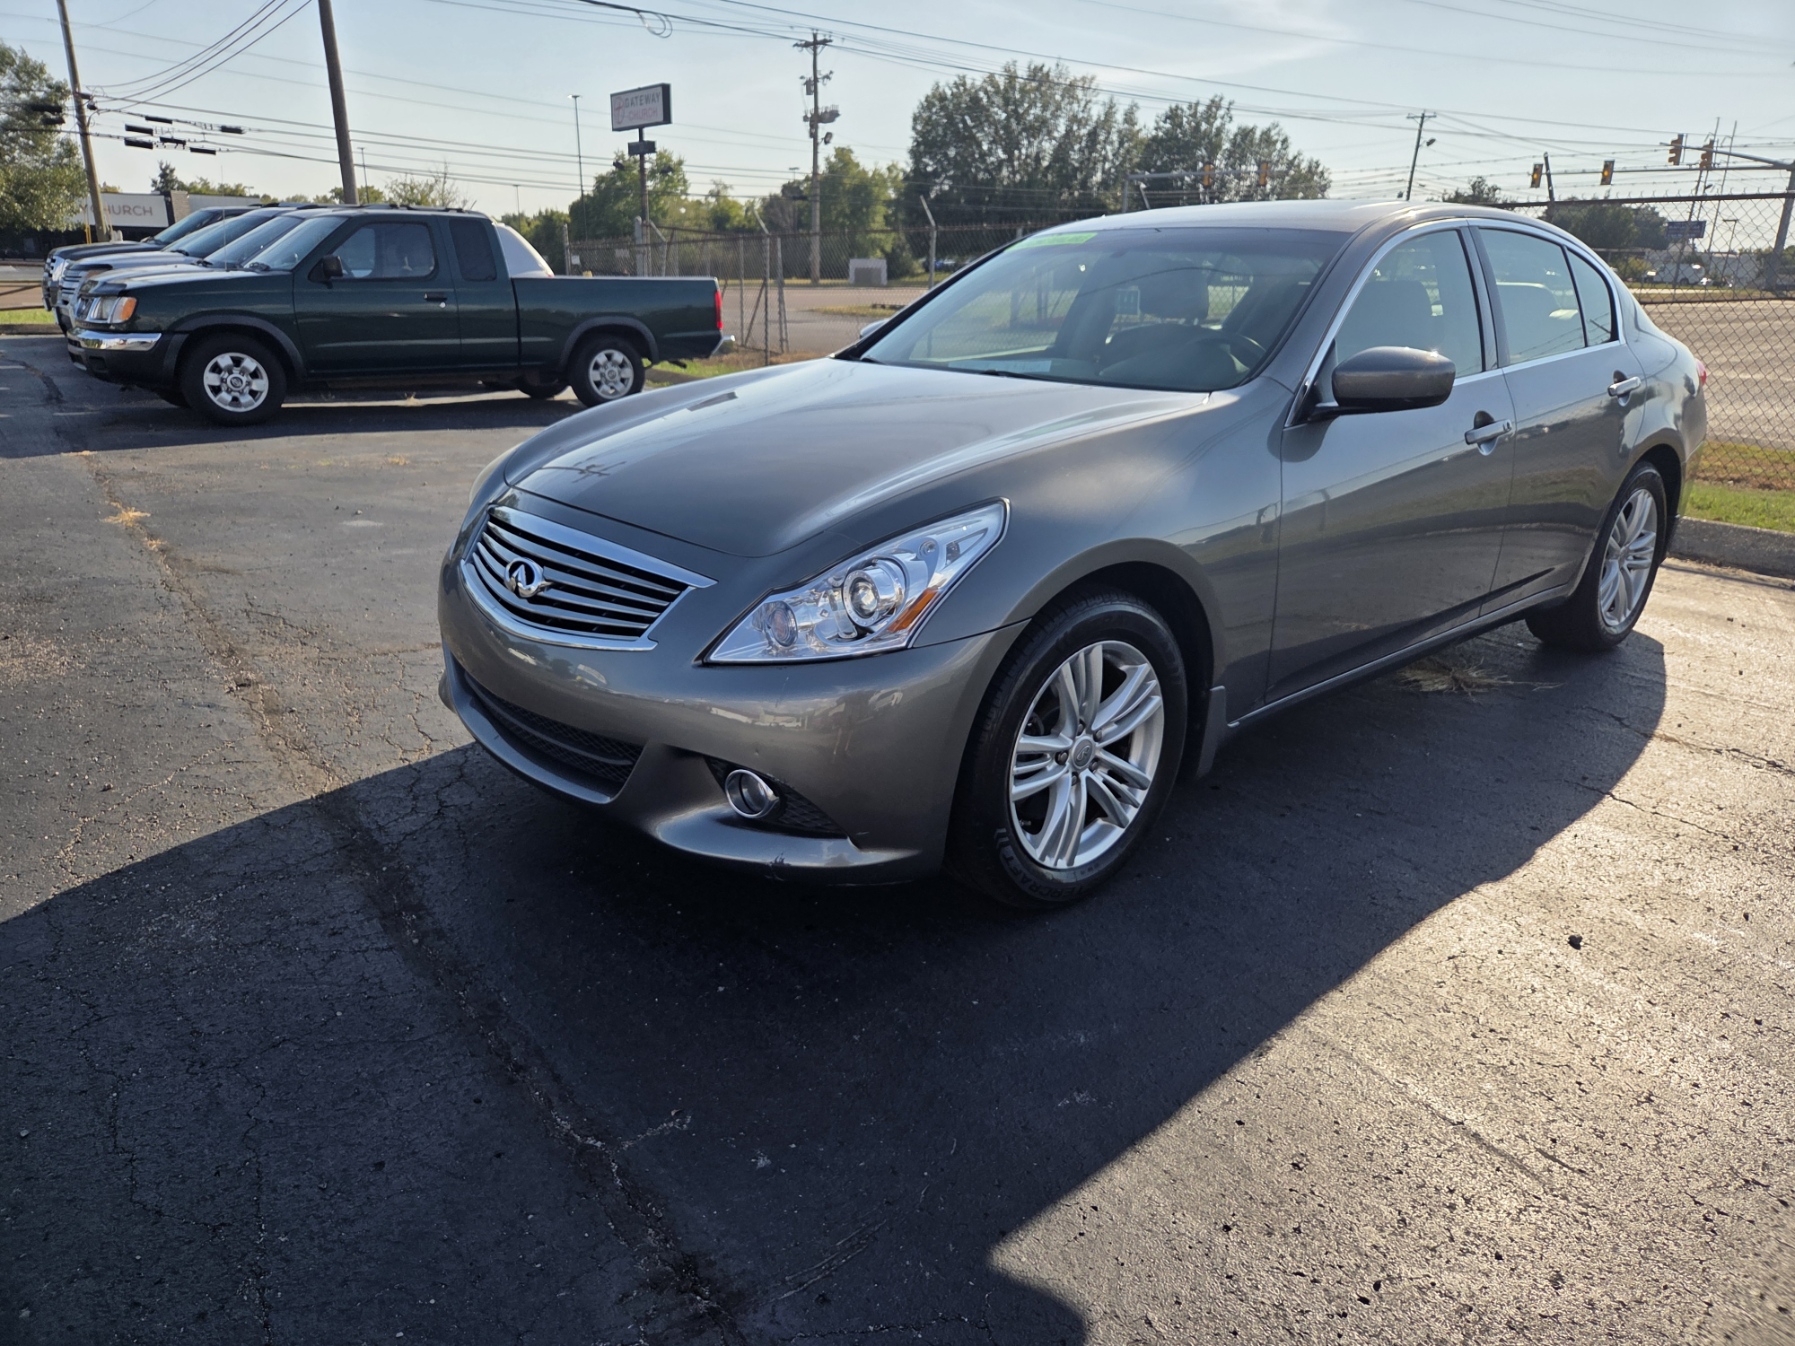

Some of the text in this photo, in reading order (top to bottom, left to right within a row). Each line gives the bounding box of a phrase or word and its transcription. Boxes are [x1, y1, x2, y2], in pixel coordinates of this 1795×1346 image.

[624, 91, 661, 109] GATEWAY
[629, 106, 659, 122] CHURCH
[90, 204, 153, 217] HURCH
